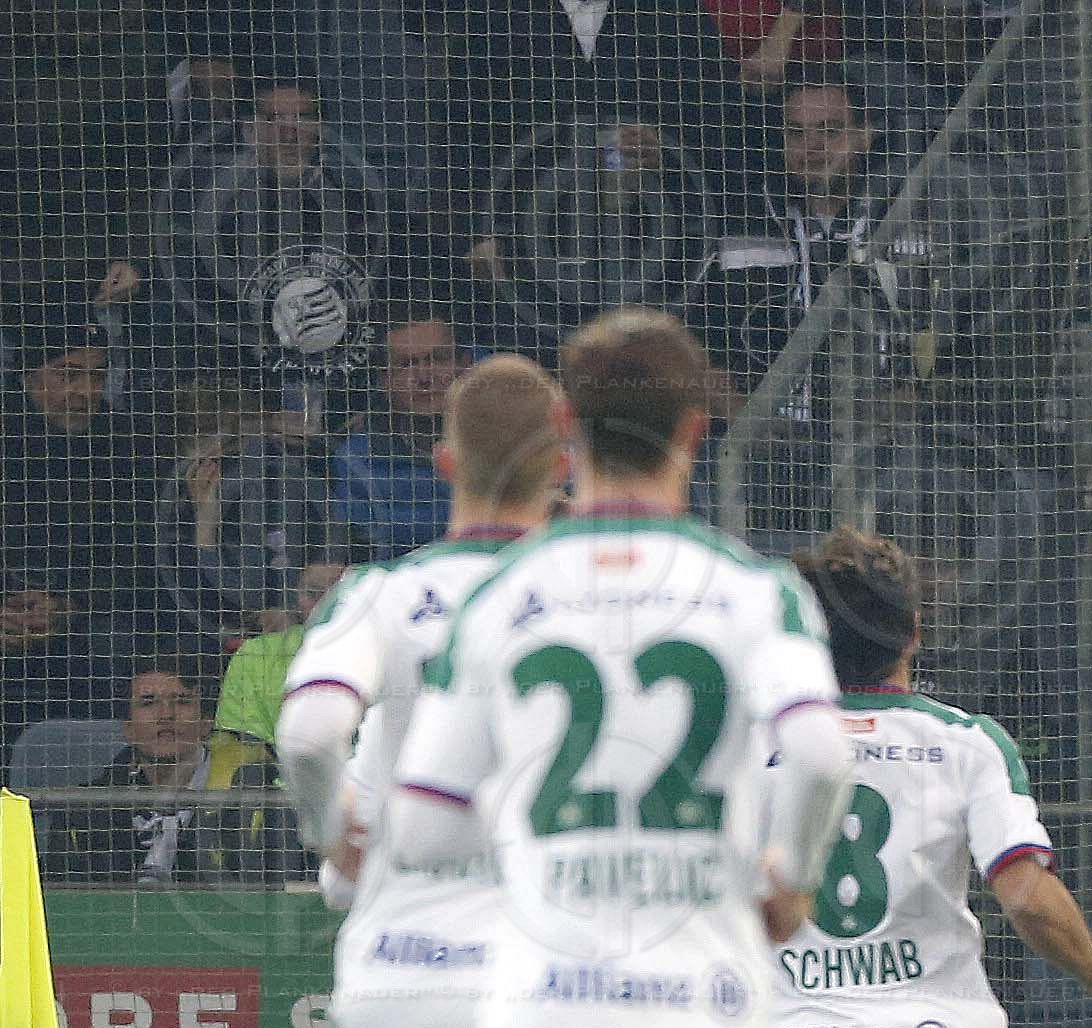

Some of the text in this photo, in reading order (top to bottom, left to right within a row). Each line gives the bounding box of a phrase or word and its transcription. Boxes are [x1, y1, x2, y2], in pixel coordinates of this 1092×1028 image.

[513, 641, 727, 837] 22
[815, 784, 891, 938] 8
[781, 940, 922, 989] SCHWAB
